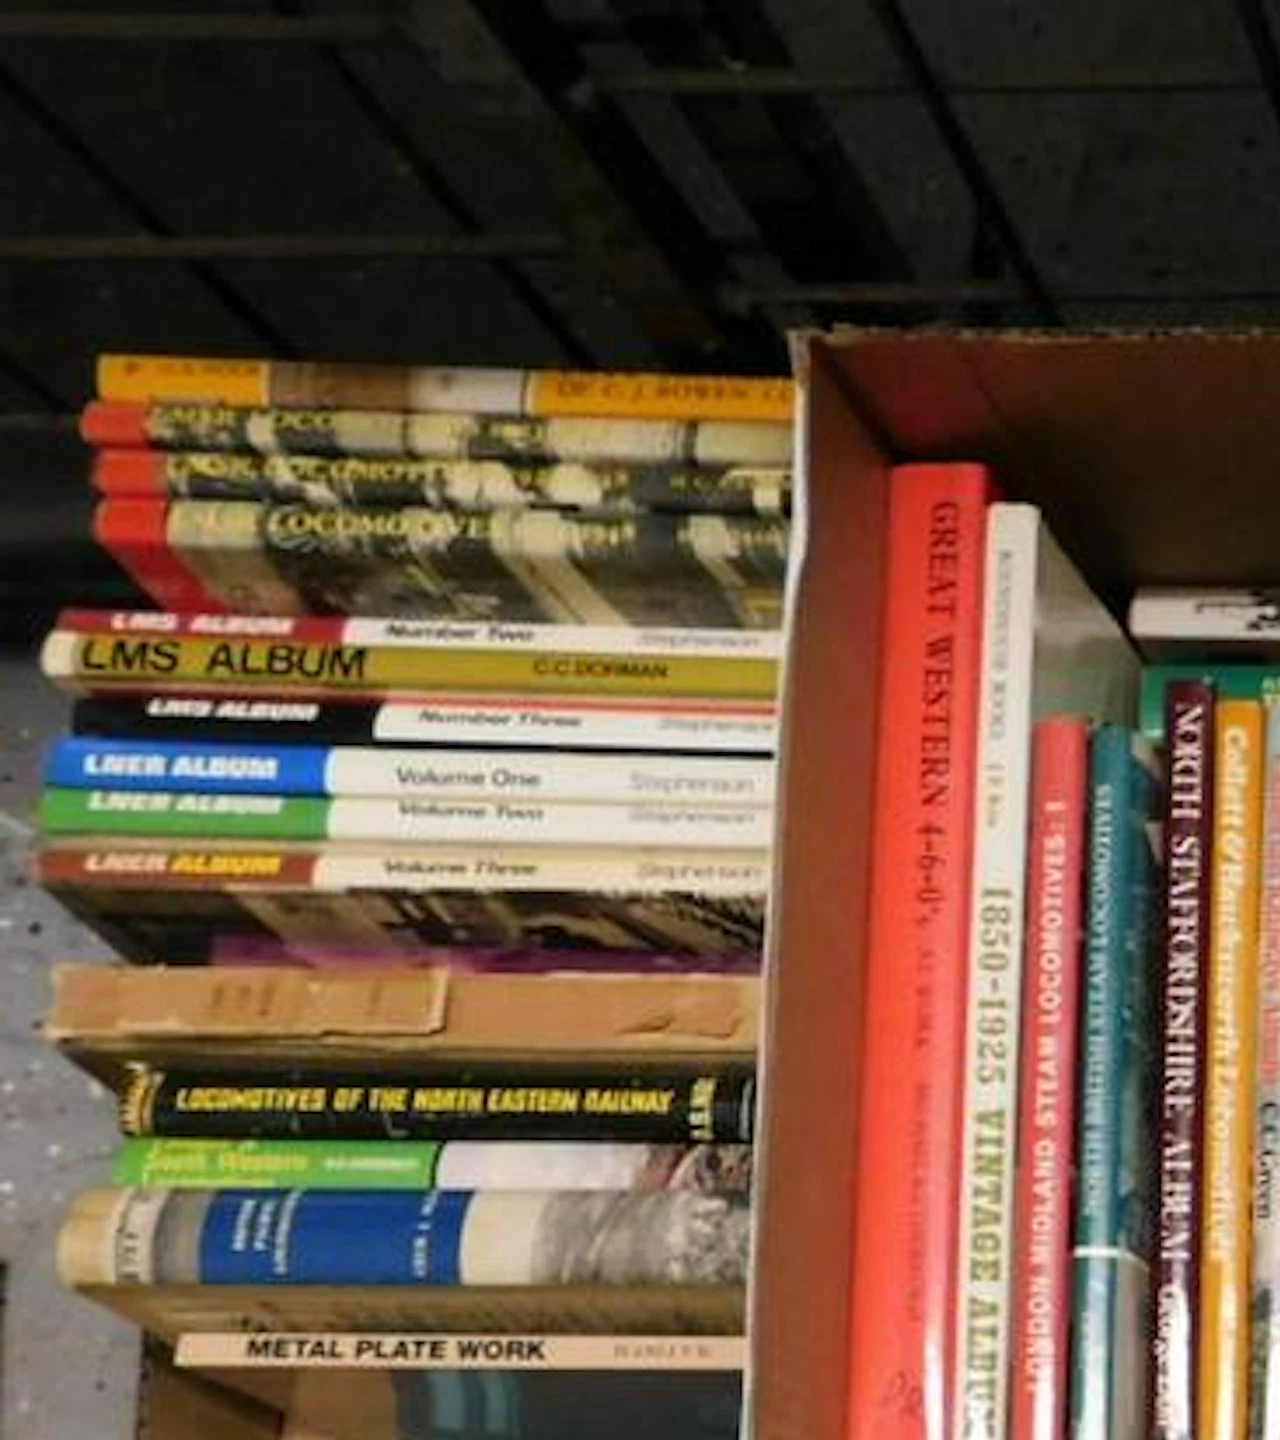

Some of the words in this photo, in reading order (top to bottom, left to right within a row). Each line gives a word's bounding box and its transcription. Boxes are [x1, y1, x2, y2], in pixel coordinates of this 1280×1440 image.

[925, 501, 960, 619] GREAT
[111, 614, 179, 632] LMS
[191, 614, 295, 634] ALBUM
[384, 624, 476, 642] Number
[81, 640, 181, 673] LMS
[207, 645, 367, 680] ALBUM
[217, 699, 320, 722] ALBUM
[418, 710, 510, 729] Number
[518, 711, 583, 729] Three
[918, 637, 955, 807] WESTERN
[83, 754, 167, 778] LNER
[171, 756, 279, 781] ALBUM
[1169, 703, 1203, 820] NORTH
[396, 769, 484, 789] Volume
[491, 770, 542, 790] One
[87, 793, 171, 813] LNER
[176, 795, 284, 816] ALBUM
[398, 803, 487, 822] Volume
[172, 854, 281, 876] ALBUM
[383, 859, 470, 878] Volume
[975, 889, 1014, 1086] 1850-1925
[1162, 835, 1200, 1119] STAFFORDSHIRE
[1032, 1036, 1062, 1128] STEAM
[175, 1088, 328, 1114] LOCOMOTIVES
[369, 1089, 407, 1114] THE
[969, 1109, 1005, 1283] VINTAGE
[1027, 1140, 1058, 1266] MIDLAND
[1159, 1132, 1194, 1261] ALBUM
[246, 1340, 347, 1360] METAL
[353, 1340, 451, 1361] PLATE
[457, 1341, 547, 1361] WORK
